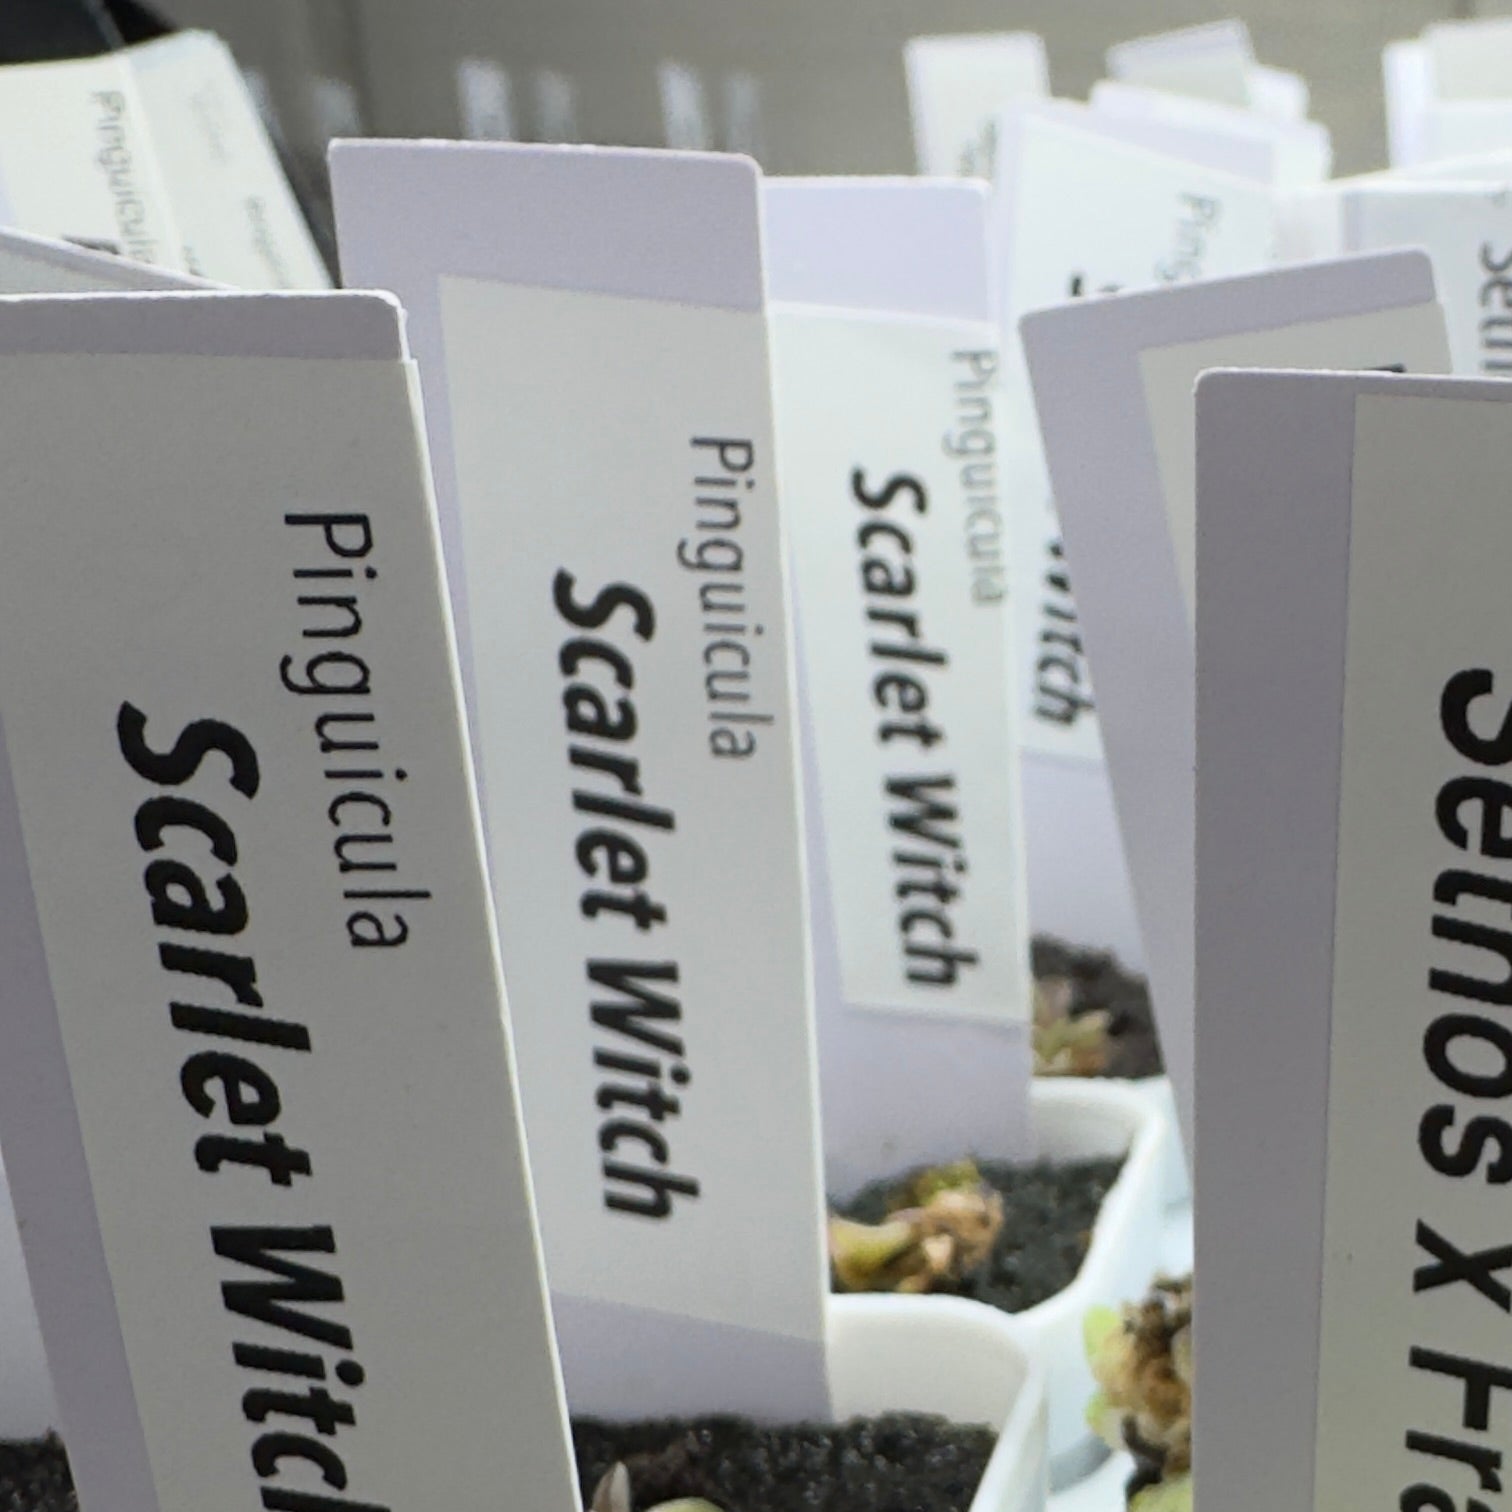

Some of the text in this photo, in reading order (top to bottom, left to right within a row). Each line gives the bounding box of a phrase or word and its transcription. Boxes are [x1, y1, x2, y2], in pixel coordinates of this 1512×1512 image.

[677, 436, 774, 760] Pinguicula
[942, 349, 1004, 608] Pinguicula
[117, 701, 312, 1187] Scarlet
[280, 514, 431, 947] Pinguicula
[553, 569, 699, 1221] Scarlet Witch
[852, 467, 979, 989] Scarlet Witch
